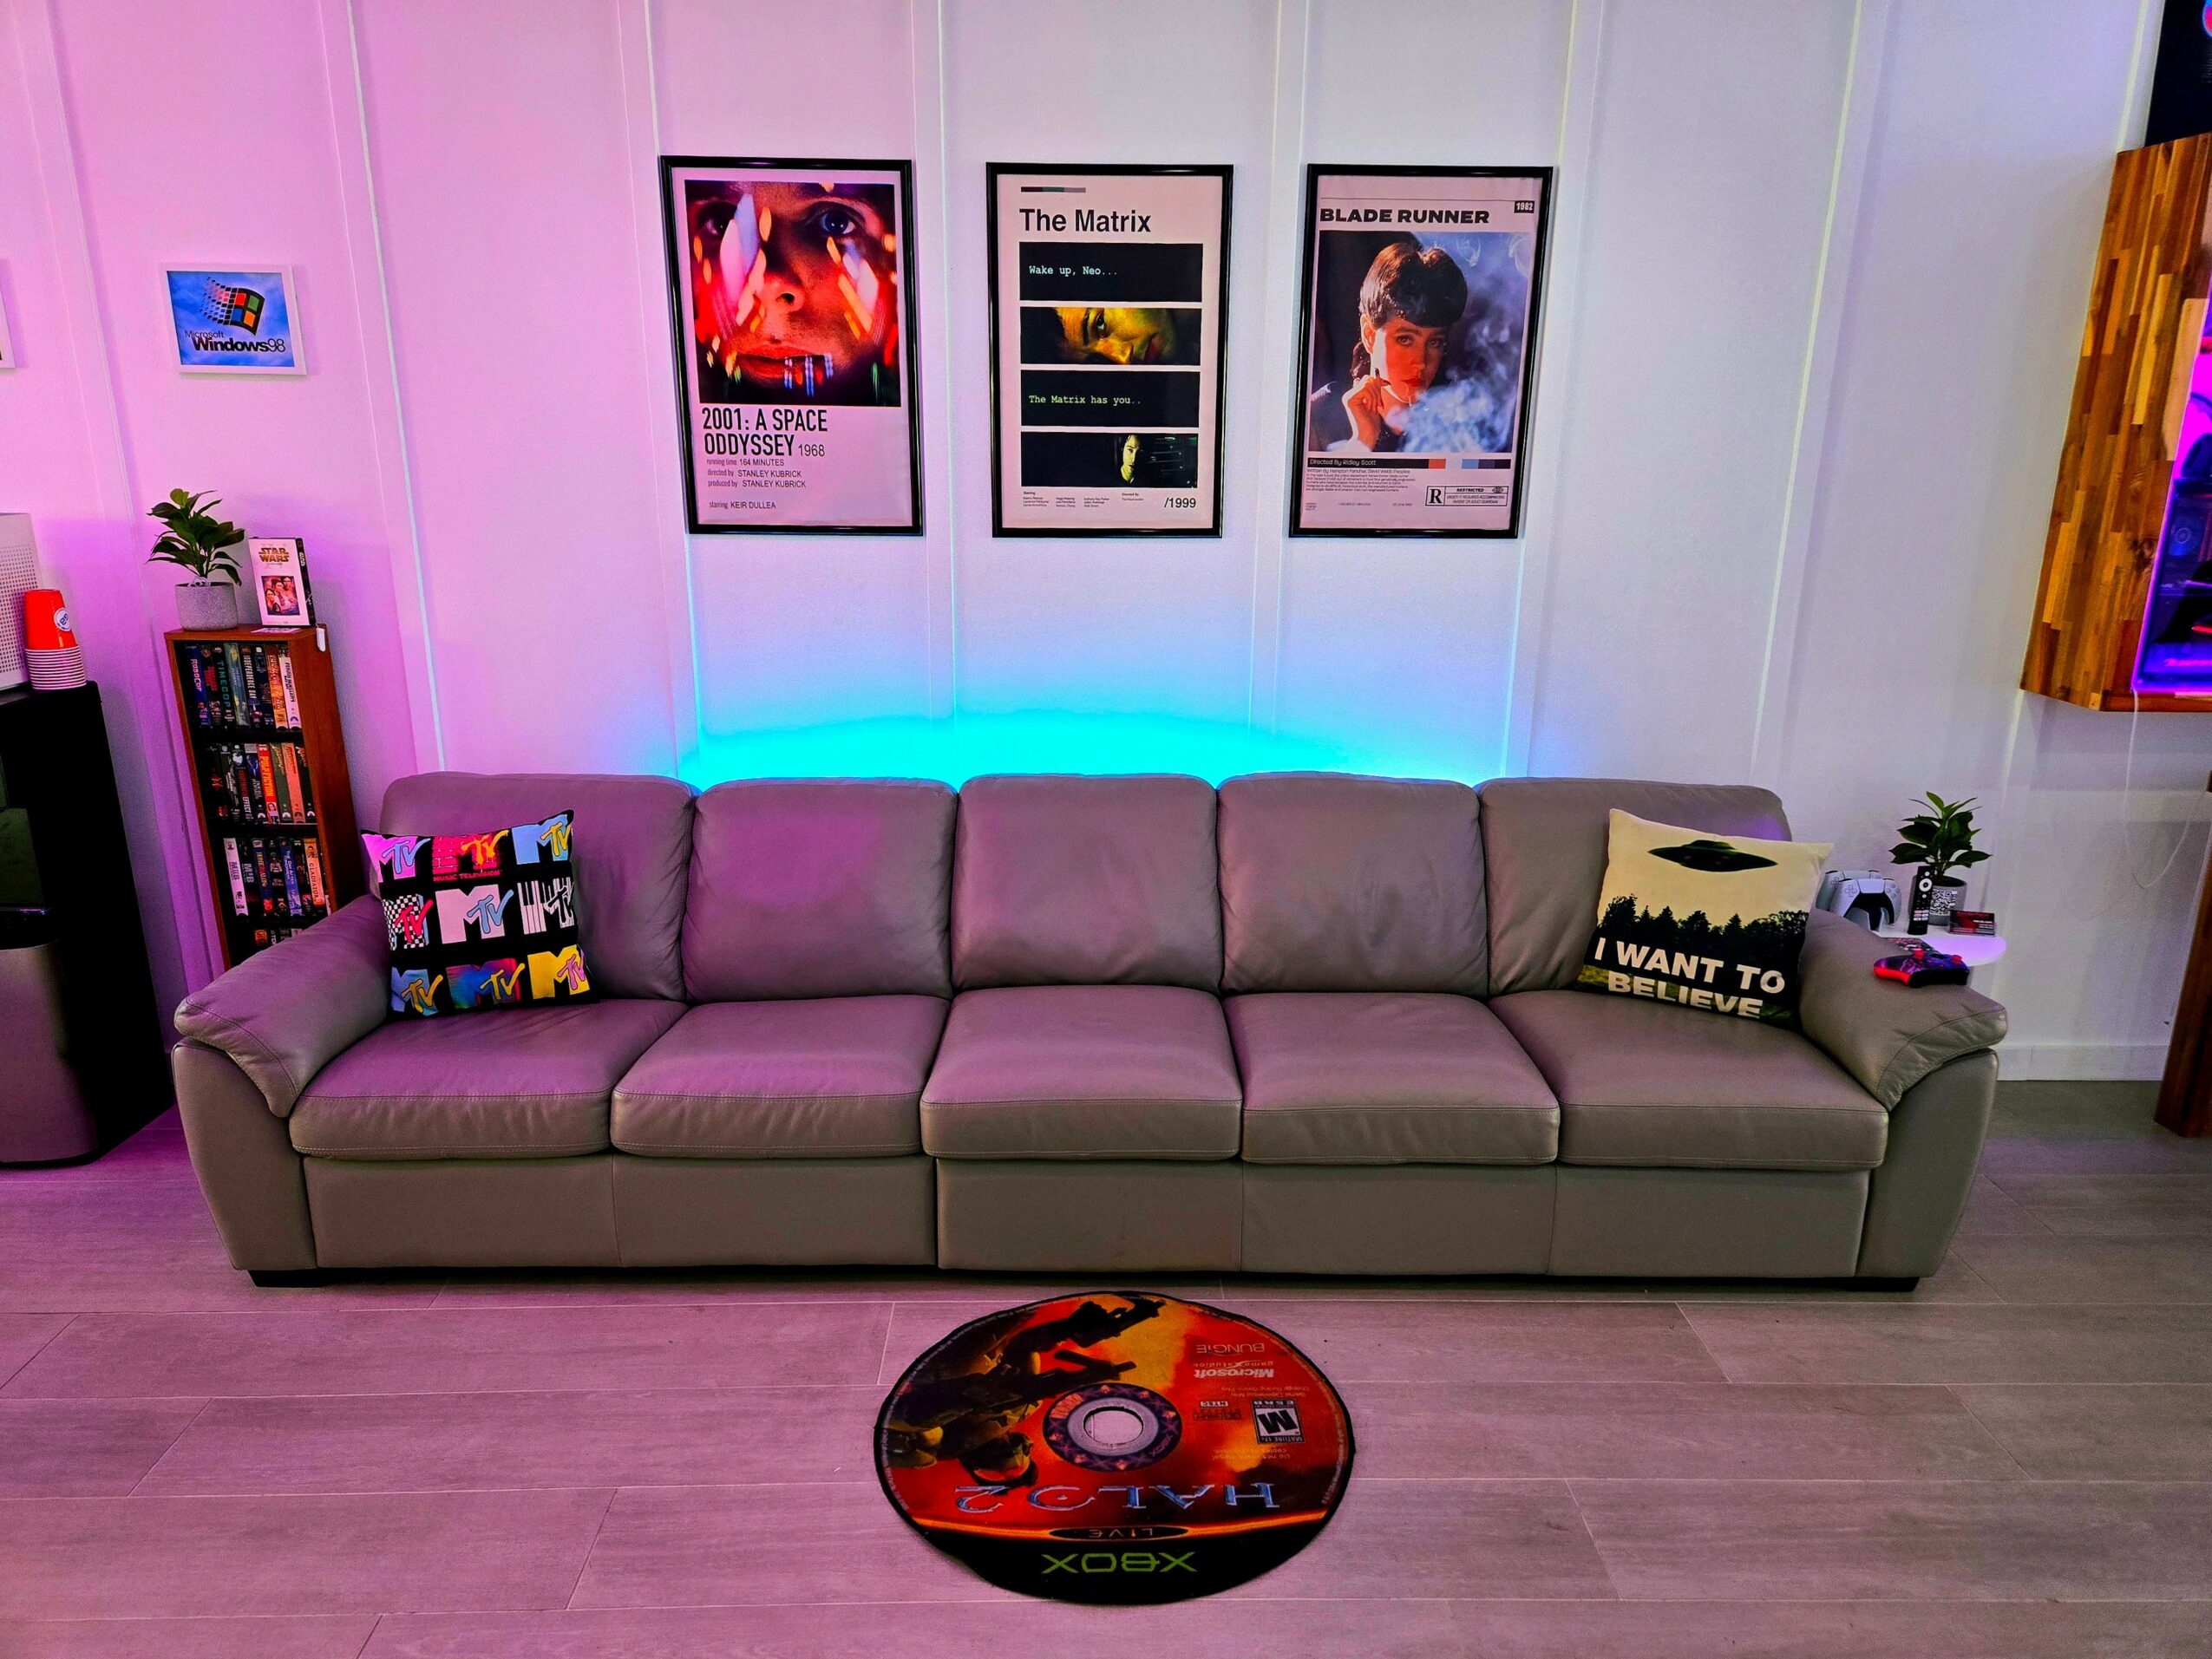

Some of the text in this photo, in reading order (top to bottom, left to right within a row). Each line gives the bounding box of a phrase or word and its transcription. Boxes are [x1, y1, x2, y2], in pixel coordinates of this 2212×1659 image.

[1319, 208, 1489, 224] BLADE RUNNER
[1515, 202, 1534, 211] 1982
[1019, 208, 1151, 232] The Matrix
[1029, 265, 1117, 277] Wake up, Neo...
[185, 330, 225, 339] Microsoft
[1029, 395, 1046, 403] The
[1051, 395, 1086, 404] Matrix
[1090, 395, 1108, 404] has
[702, 407, 828, 432] 2001: A SPACE
[704, 433, 825, 457] ODDYSSEY 1968
[1163, 497, 1196, 508] /1999
[1428, 488, 1443, 504] R
[217, 661, 231, 708] TIMECOP
[260, 755, 274, 796] PULP FICTION
[241, 795, 252, 813] EFFECT
[308, 862, 320, 898] GLADIATOR
[459, 869, 501, 879] TELEVISION
[435, 884, 514, 944] MTV
[1594, 937, 1785, 994] I WANT TO
[1607, 970, 1764, 1019] BELIEVE
[1194, 1368, 1274, 1379] Microsoft
[1257, 1410, 1298, 1434] M
[954, 1481, 1280, 1513] HALO 2
[1088, 1526, 1154, 1538] LIVE
[1041, 1551, 1198, 1574] XBOX
